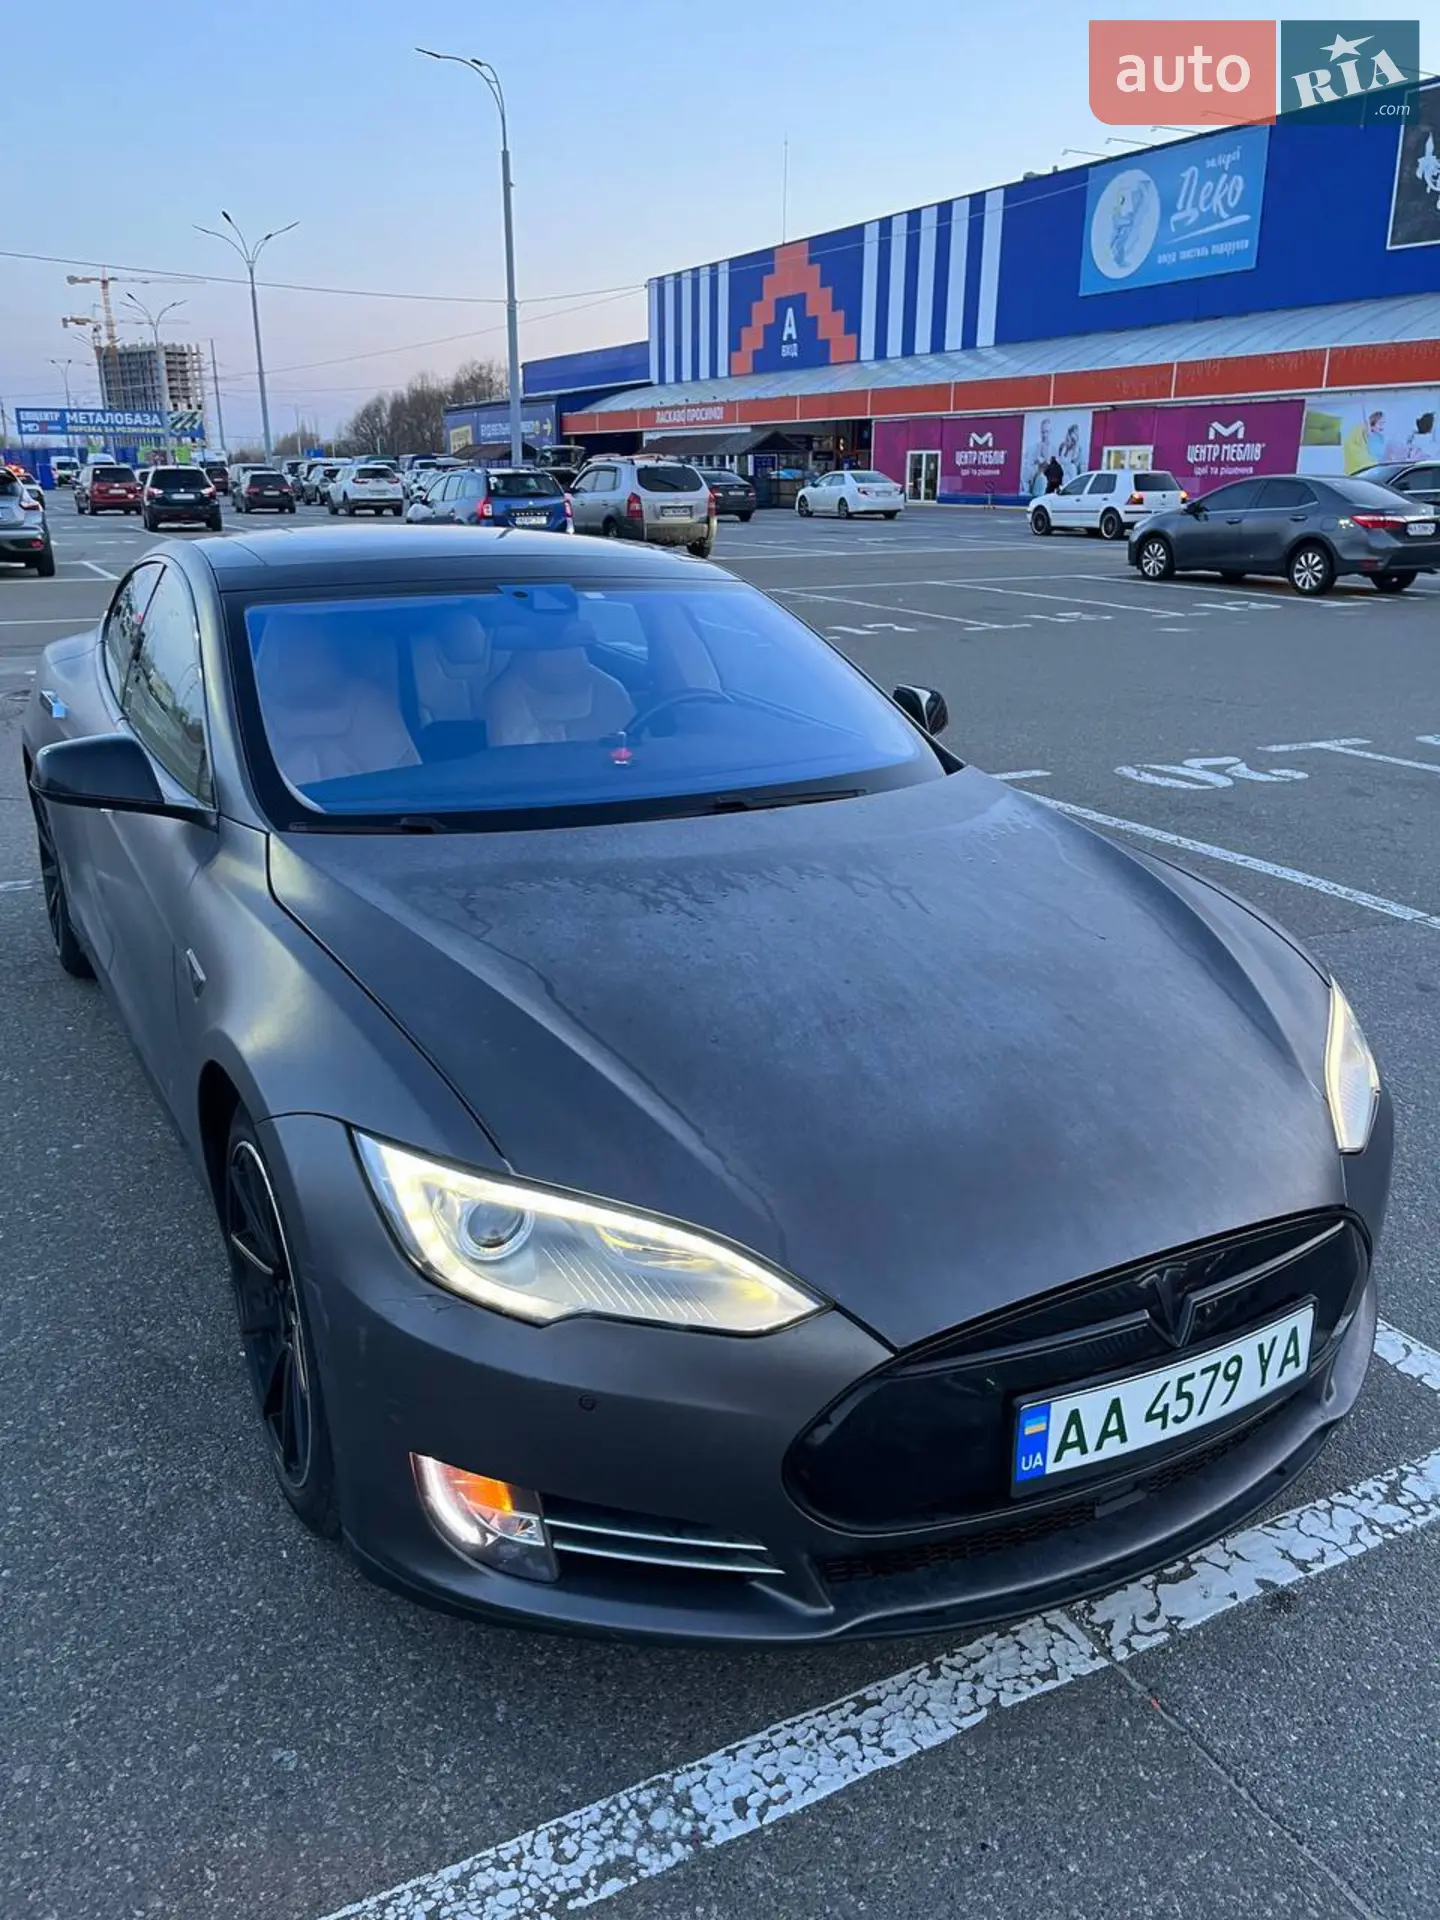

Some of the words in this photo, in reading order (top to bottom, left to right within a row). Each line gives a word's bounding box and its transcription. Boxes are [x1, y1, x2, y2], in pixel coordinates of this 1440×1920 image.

[1170, 165, 1245, 232] Деко
[65, 411, 161, 426] МЕТАЛОБАЗА
[955, 450, 977, 466] ЦЕНТР
[1187, 443, 1220, 463] ЦЕНТР
[1220, 442, 1262, 462] МЕБЛІВ
[1053, 1396, 1128, 1463] AA
[1144, 1354, 1244, 1431] 4579
[1257, 1326, 1302, 1388] YA
[1020, 1451, 1044, 1472] UA
